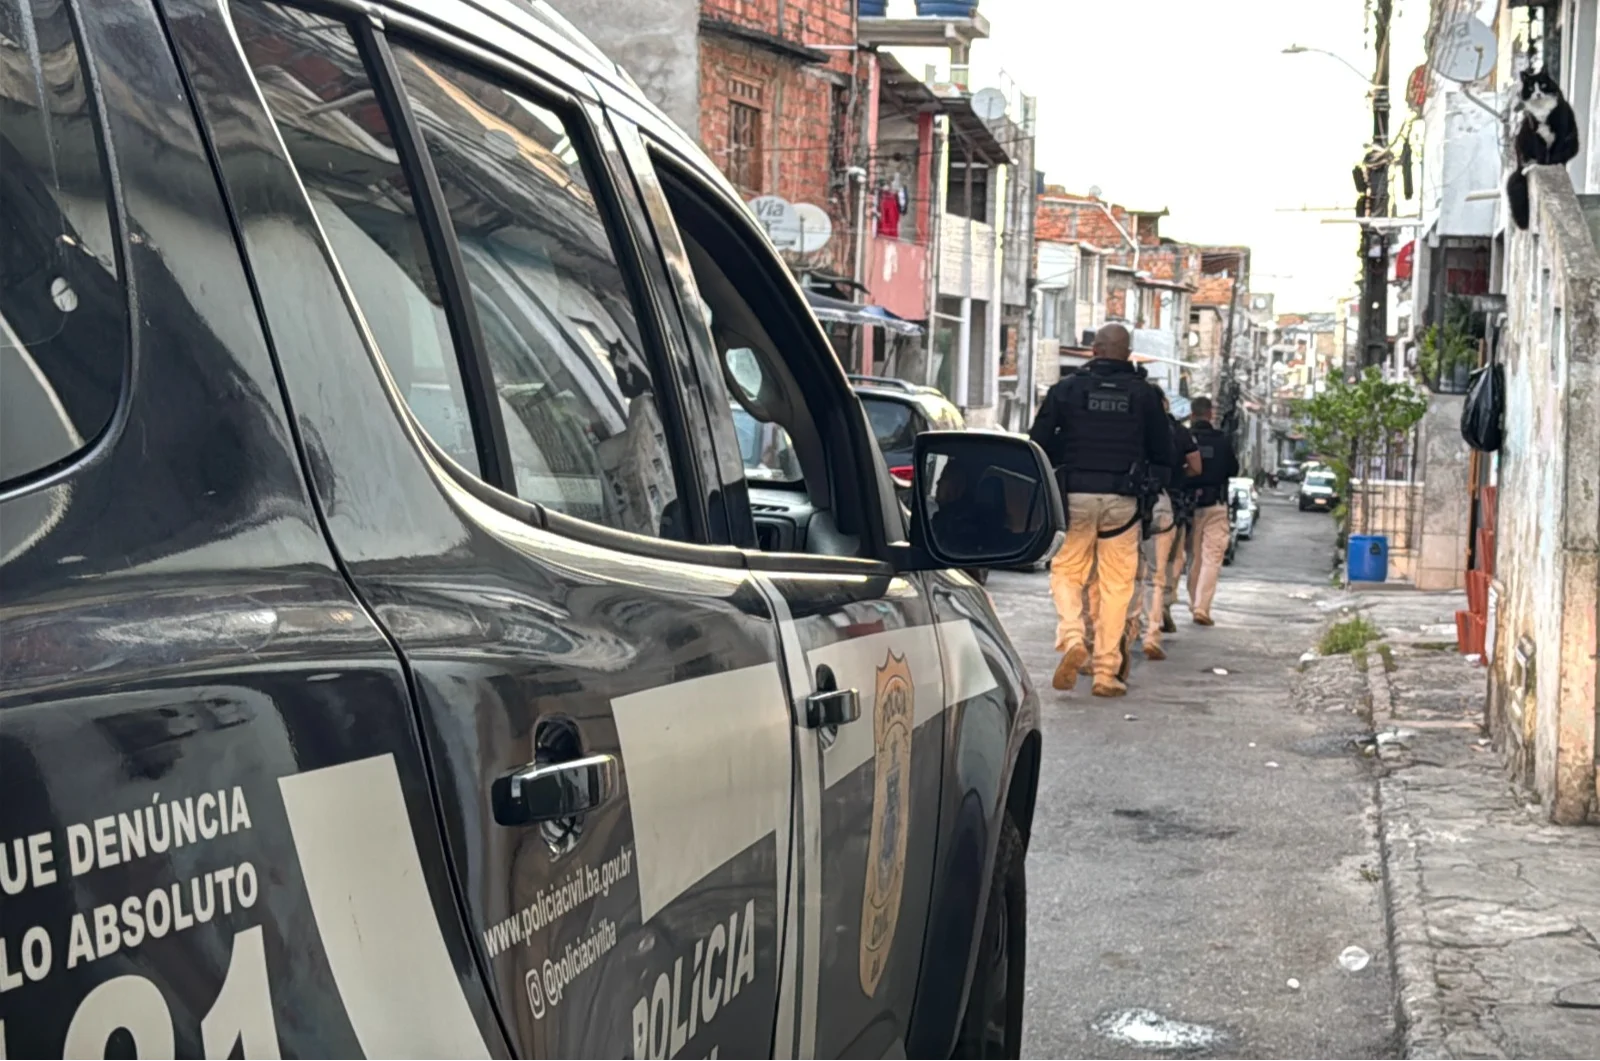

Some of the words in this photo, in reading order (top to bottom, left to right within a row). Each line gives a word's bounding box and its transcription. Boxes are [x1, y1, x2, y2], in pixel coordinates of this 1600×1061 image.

[1088, 399, 1129, 412] DEIC
[67, 785, 252, 877] DENÚNCIA
[67, 861, 258, 969] ABSOLUTO
[483, 846, 633, 958] www.policiacivil.ba.gov.br
[632, 898, 755, 1061] POLÍCIA
